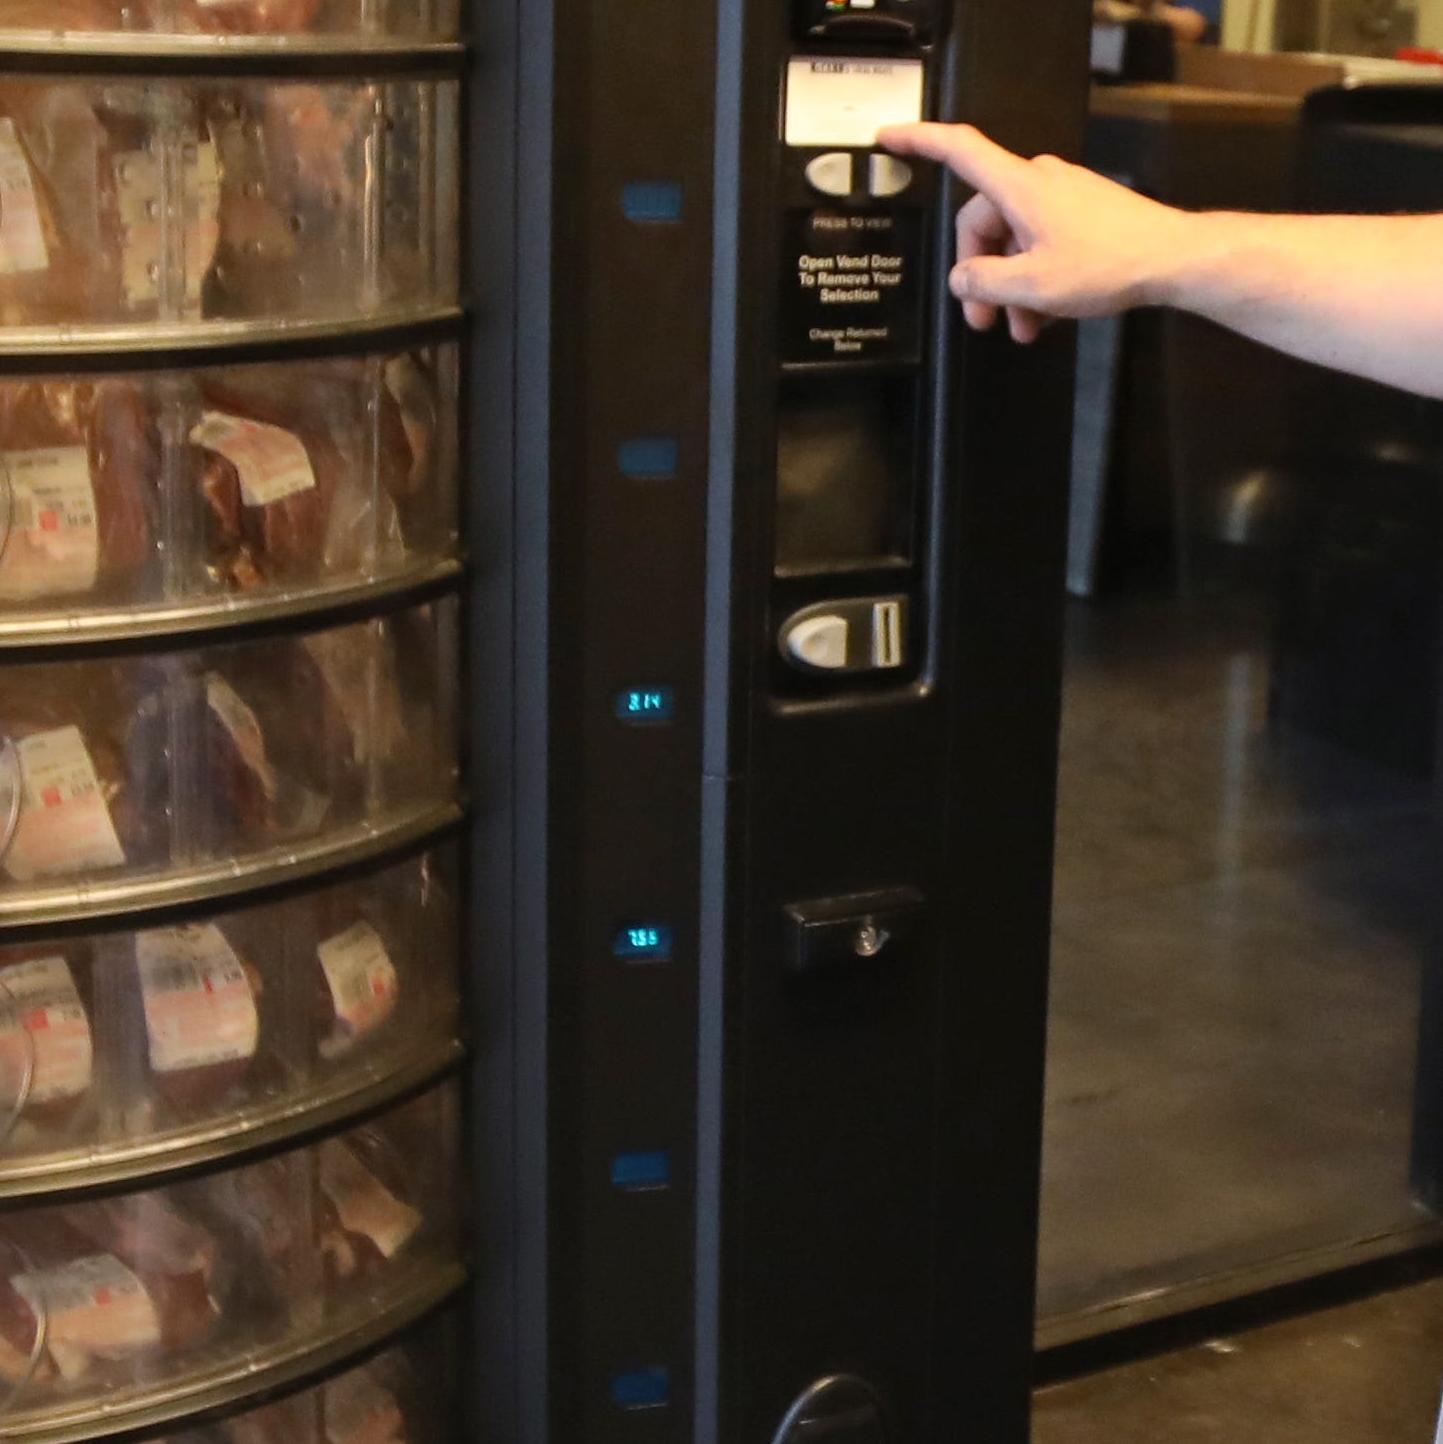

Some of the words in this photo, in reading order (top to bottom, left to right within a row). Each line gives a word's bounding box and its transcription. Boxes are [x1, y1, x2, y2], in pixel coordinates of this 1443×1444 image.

[798, 255, 834, 271] Open
[836, 254, 869, 268] Vend
[871, 254, 902, 268] Door
[799, 272, 815, 285] To
[817, 272, 869, 285] Remove
[871, 271, 901, 285] Your
[820, 288, 879, 302] Selection
